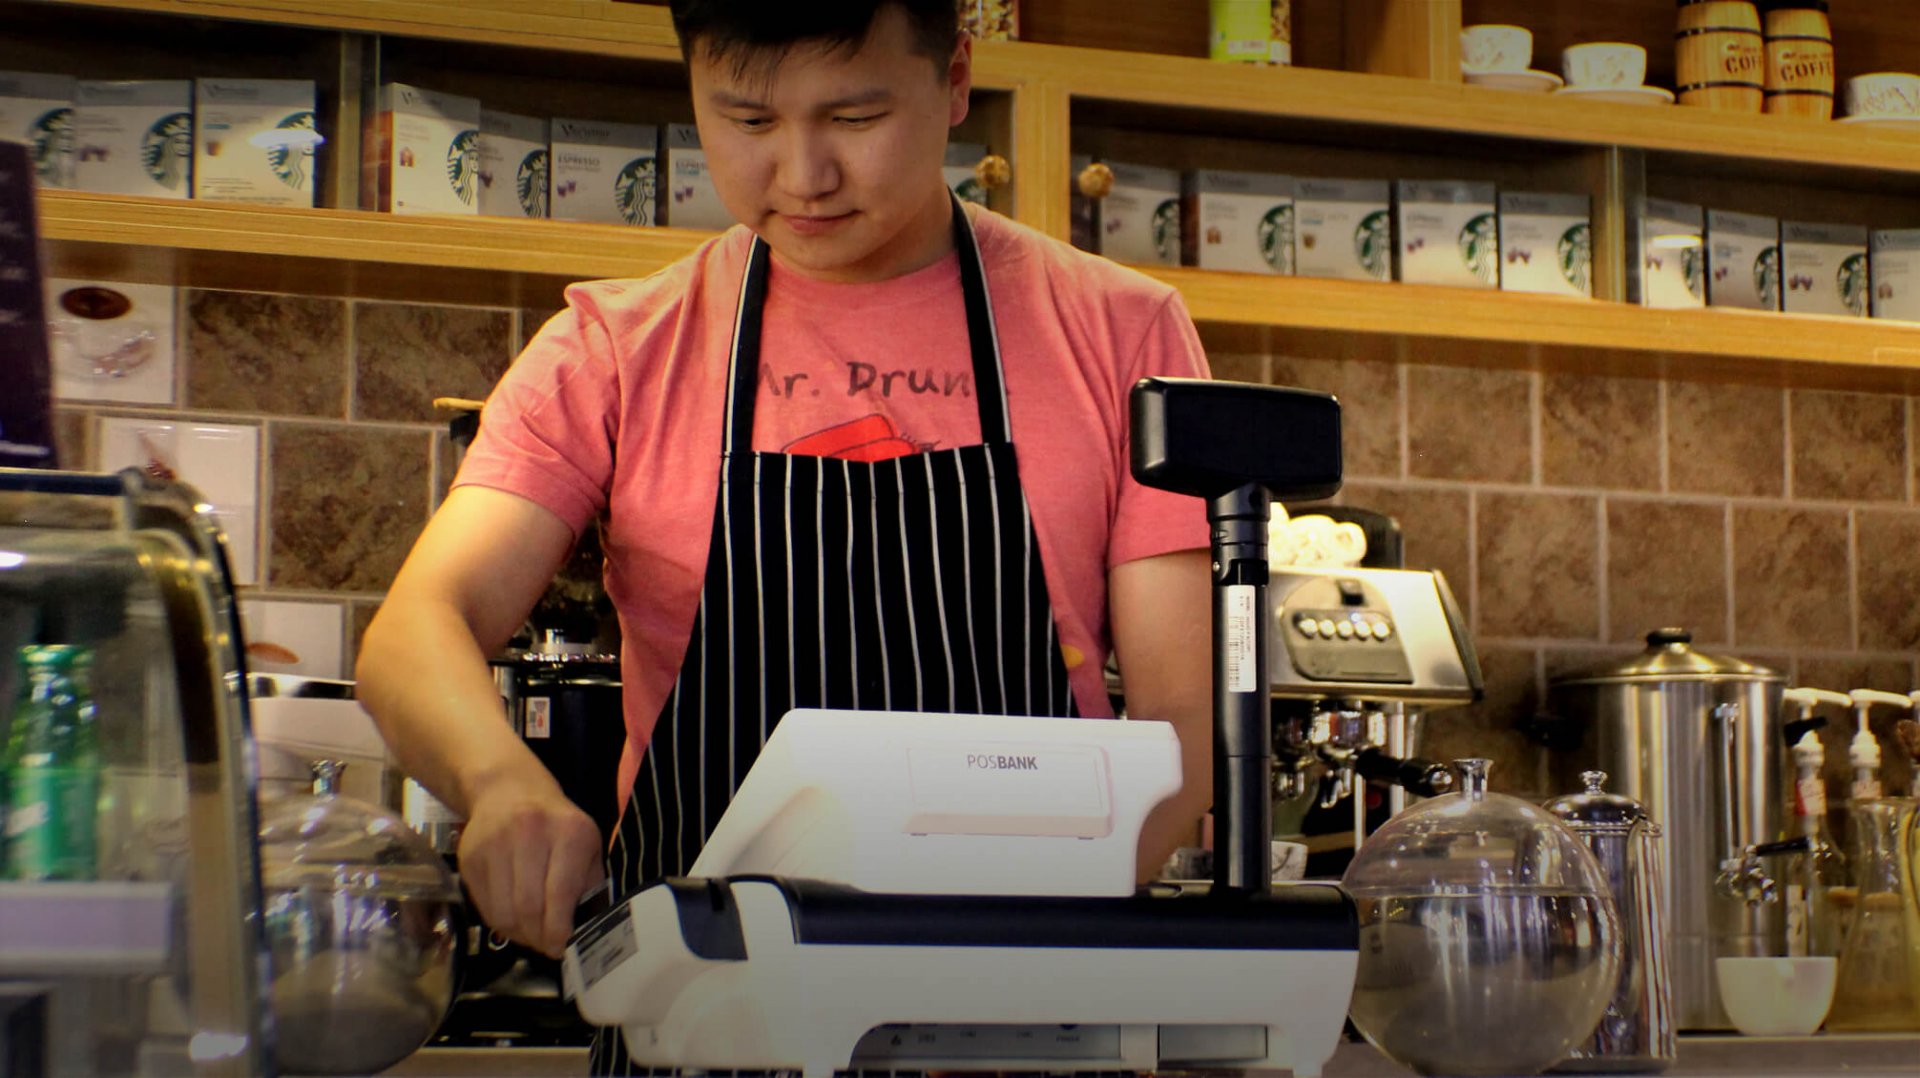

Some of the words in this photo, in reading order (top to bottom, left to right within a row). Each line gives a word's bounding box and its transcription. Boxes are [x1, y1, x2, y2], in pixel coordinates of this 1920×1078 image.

[1726, 56, 1762, 73] COF
[847, 361, 971, 398] Drun
[967, 755, 1038, 770] POSBANK
